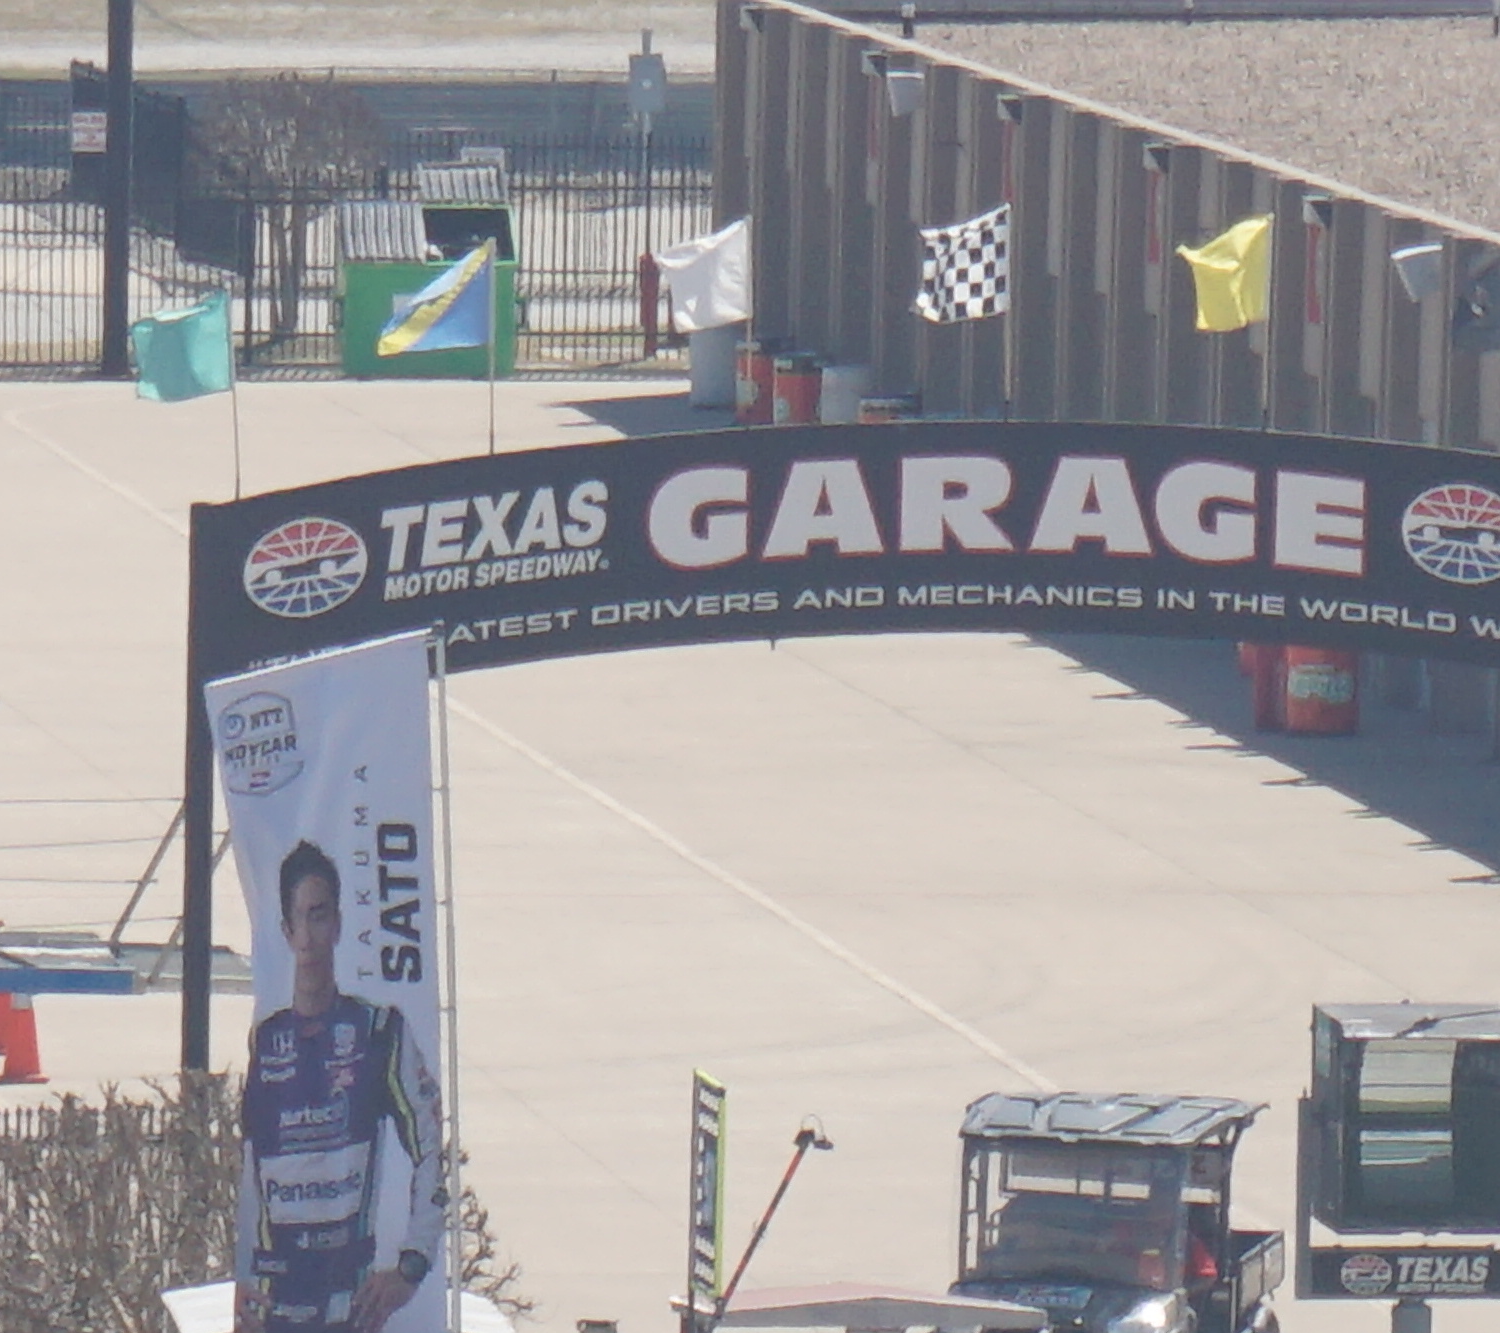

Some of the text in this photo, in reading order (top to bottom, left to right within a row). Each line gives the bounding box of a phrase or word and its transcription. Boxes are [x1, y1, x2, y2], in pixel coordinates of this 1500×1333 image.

[380, 480, 610, 572] TEXAS
[646, 455, 1366, 574] GARAGE
[384, 550, 603, 602] MOTOR SPEEDWAY
[426, 608, 577, 648] ATEST
[591, 591, 779, 625] DRIVERS
[793, 586, 884, 609] AND
[899, 585, 1143, 608] MECHANICS
[1157, 588, 1194, 609] IN
[1210, 591, 1285, 617] THE
[1303, 599, 1457, 634] WORLD
[249, 707, 284, 731] NTT
[354, 764, 375, 980] TAKUMA
[377, 823, 423, 983] SATO
[1397, 1256, 1490, 1283] TEXAS
